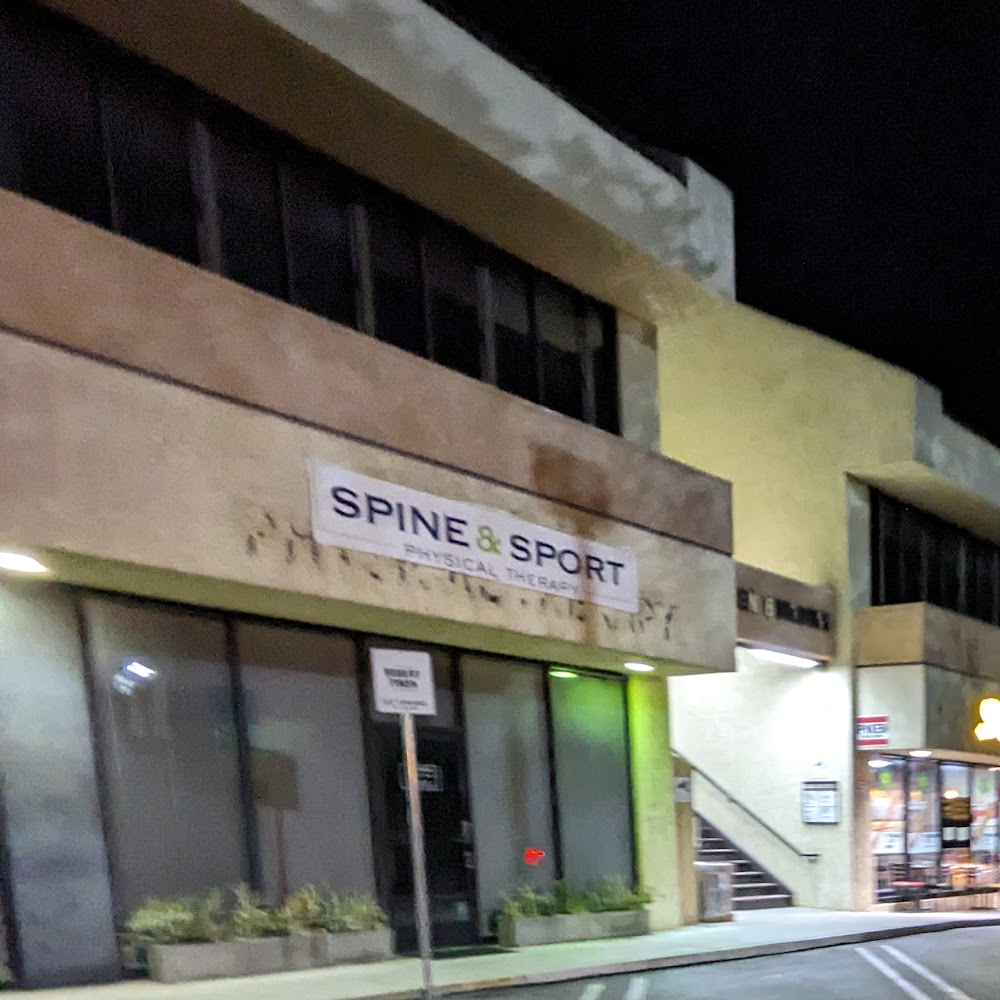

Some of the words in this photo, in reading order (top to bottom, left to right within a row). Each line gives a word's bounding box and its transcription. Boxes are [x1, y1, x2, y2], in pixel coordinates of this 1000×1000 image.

[330, 485, 470, 548] SPINE
[476, 524, 500, 554] &
[509, 533, 625, 586] SPORT
[403, 542, 498, 578] PHYSICAL
[506, 567, 580, 594] THERAPY
